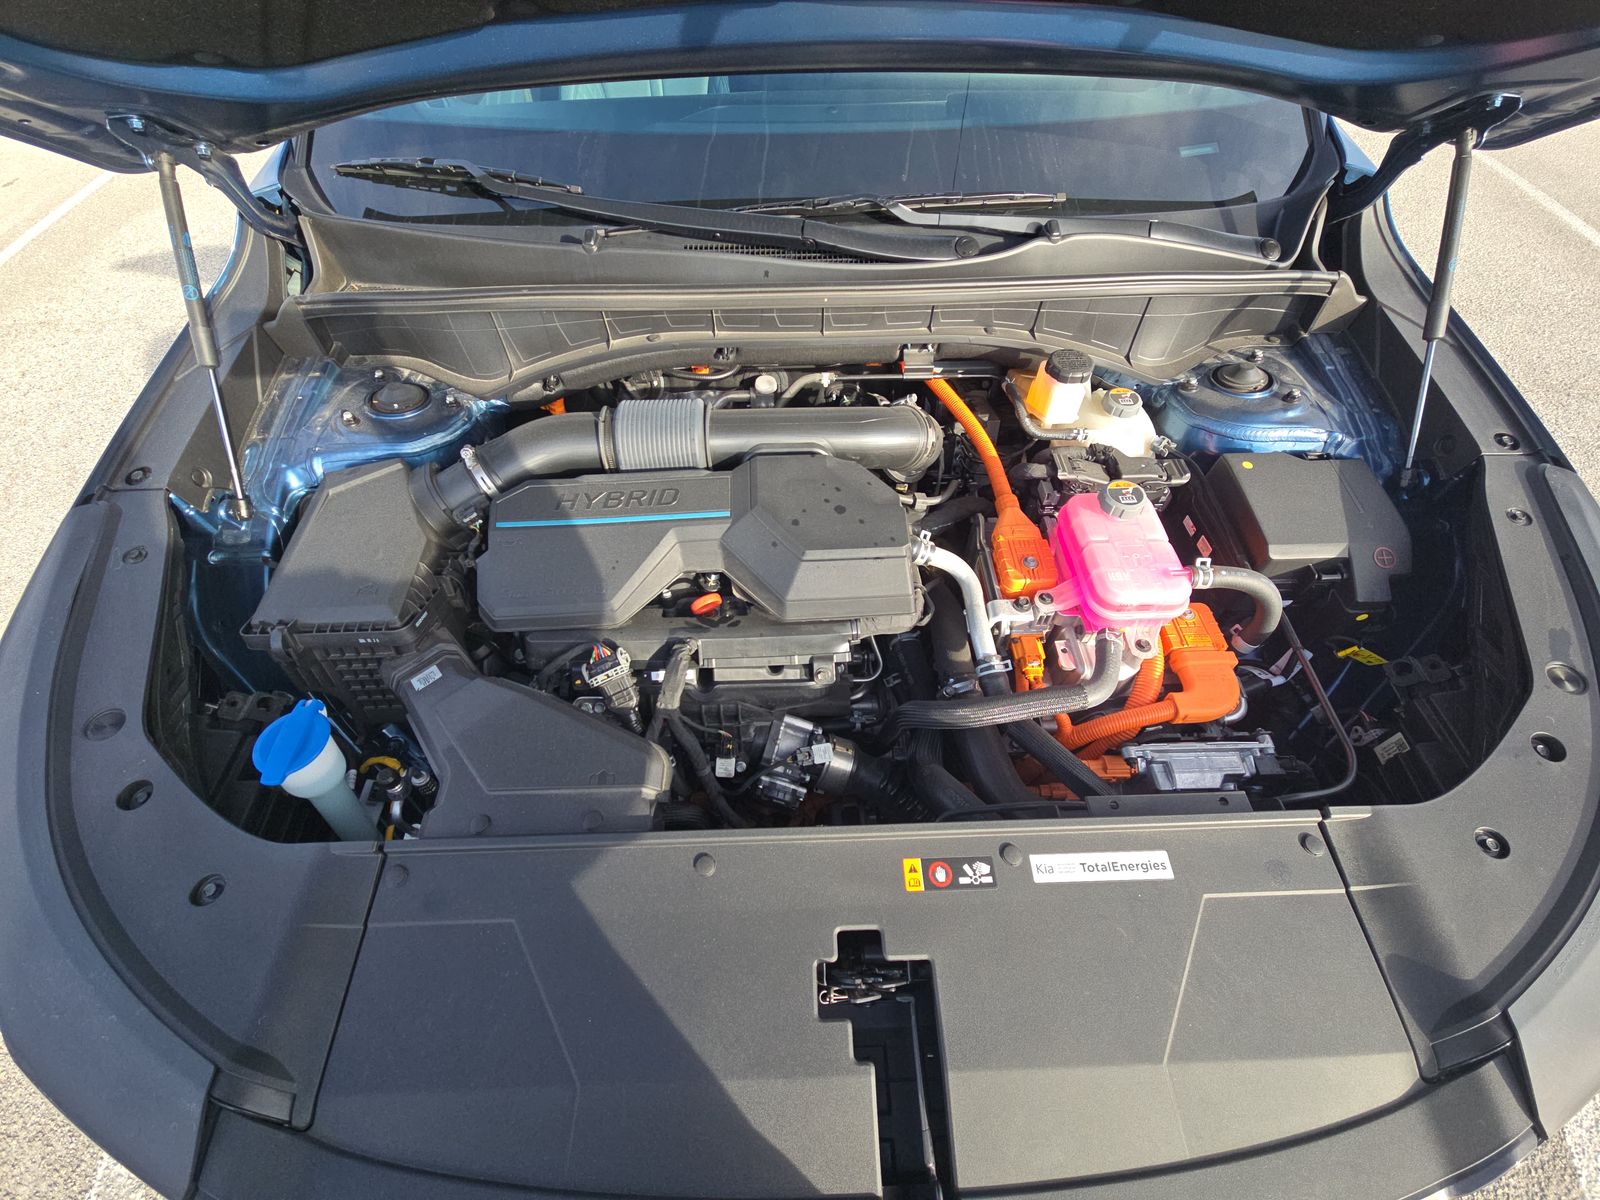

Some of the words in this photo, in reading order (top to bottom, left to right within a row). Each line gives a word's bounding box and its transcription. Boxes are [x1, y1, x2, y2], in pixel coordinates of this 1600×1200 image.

[554, 487, 680, 512] HYBRID
[1035, 863, 1055, 875] Kia
[1079, 860, 1168, 873] TotalEnergies
